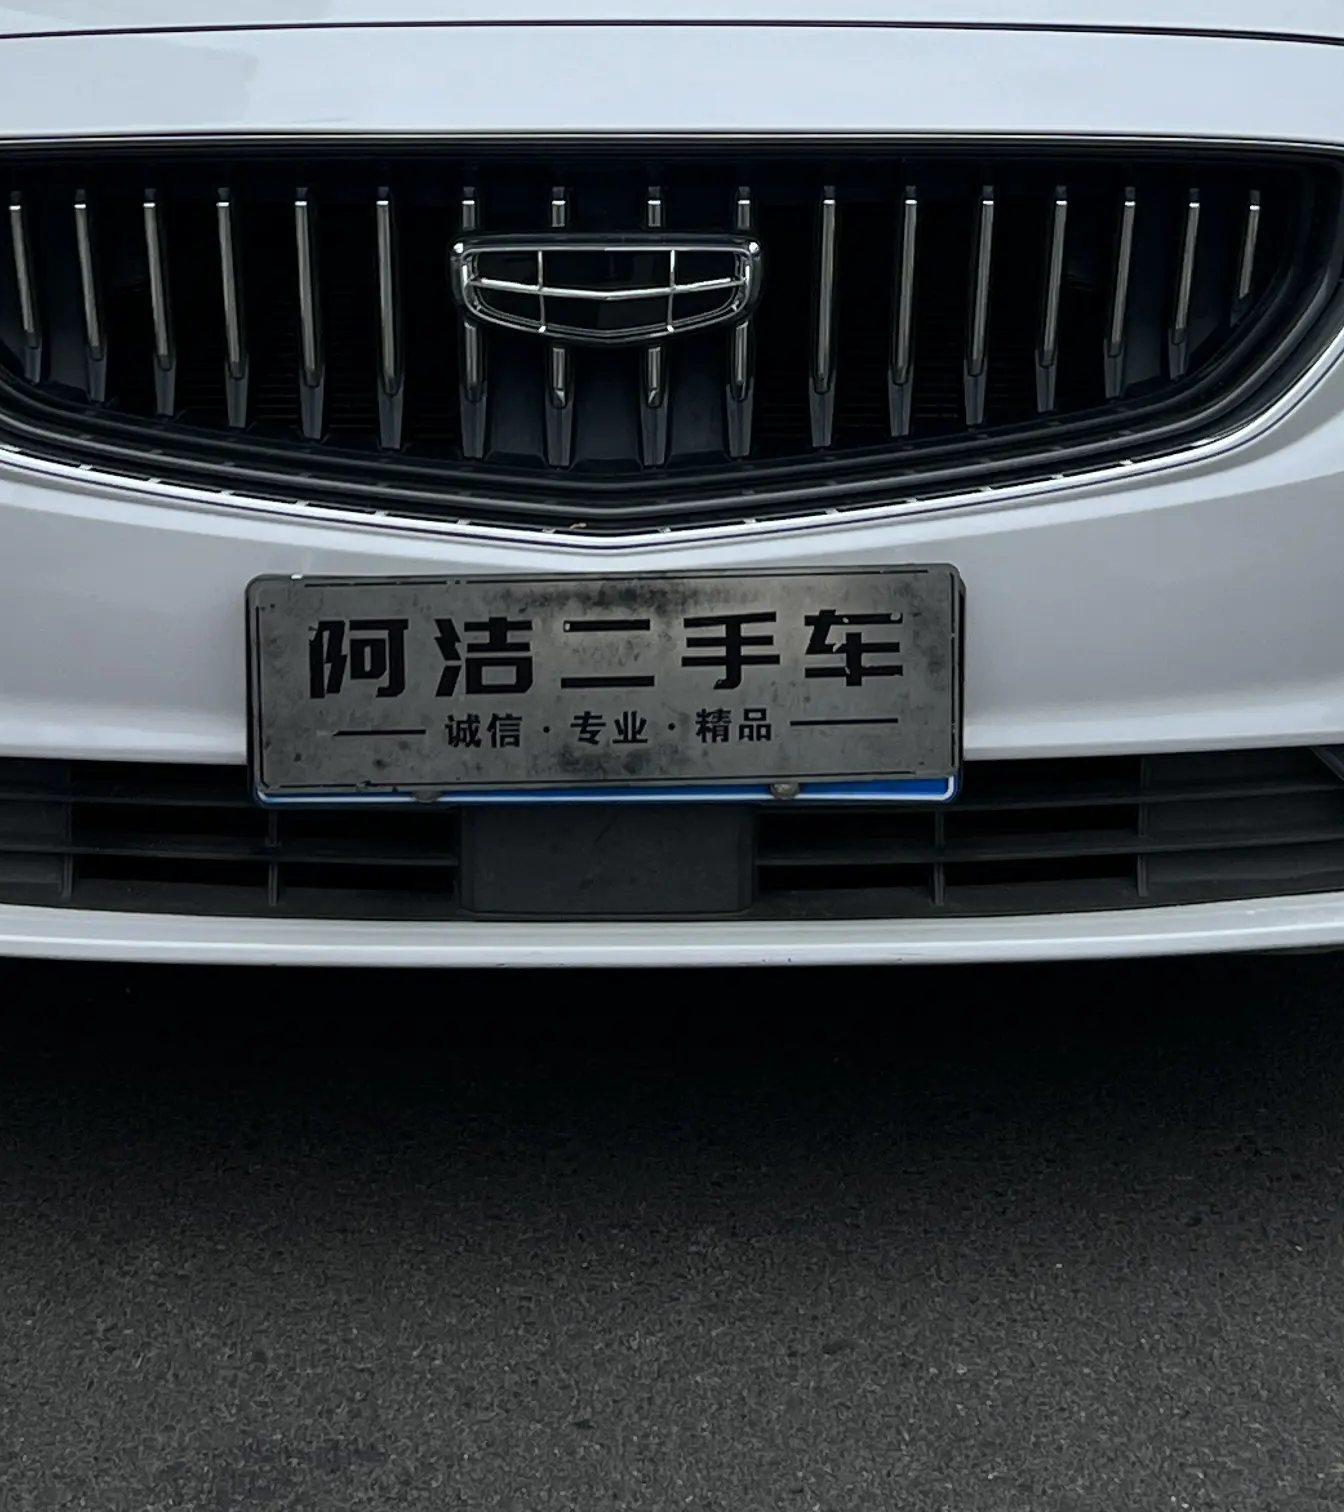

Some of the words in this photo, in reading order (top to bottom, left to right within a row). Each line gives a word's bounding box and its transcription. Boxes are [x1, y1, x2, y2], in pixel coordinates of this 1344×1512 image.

[308, 607, 904, 699] 阿洁二手车
